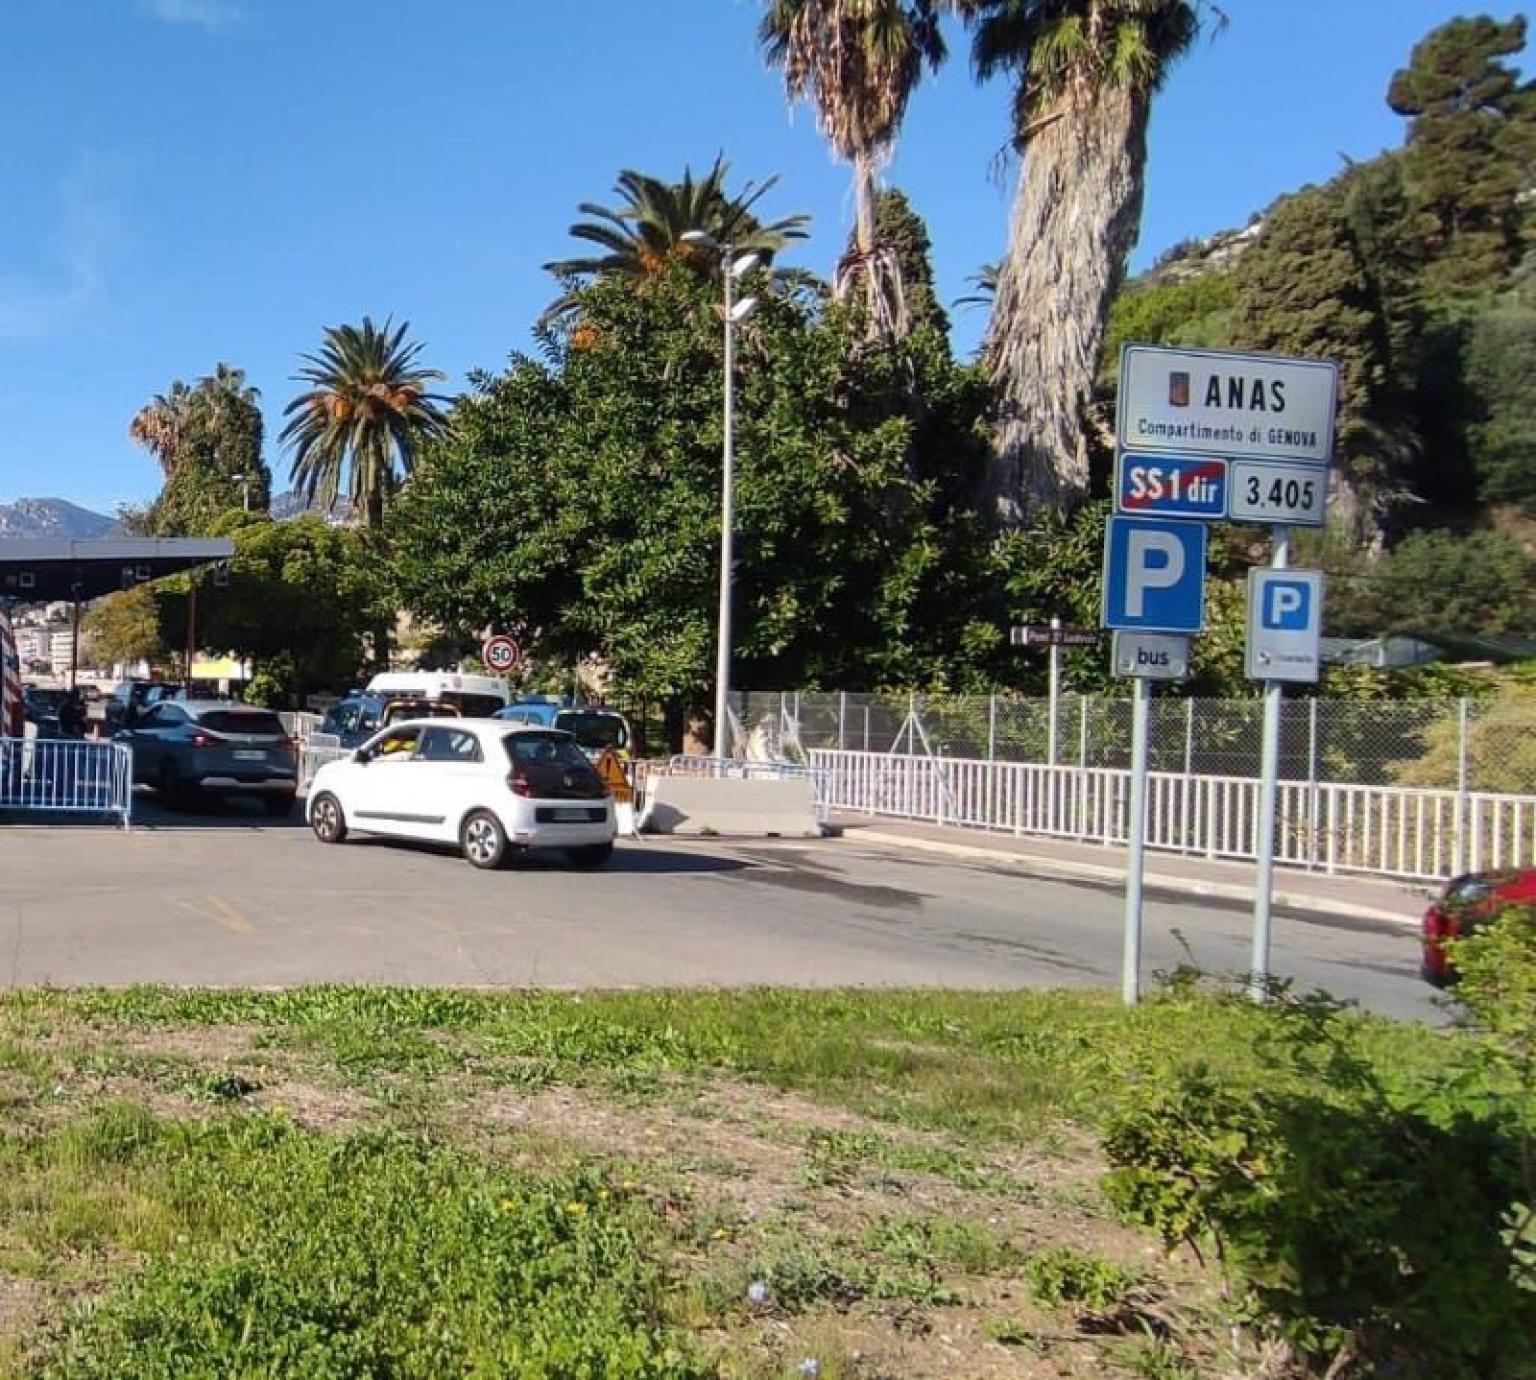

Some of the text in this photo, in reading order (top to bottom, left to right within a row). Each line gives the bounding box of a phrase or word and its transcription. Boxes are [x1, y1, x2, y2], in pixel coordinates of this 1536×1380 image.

[1204, 375, 1286, 413] ANAS
[1138, 418, 1317, 447] Compartimento di GENOVA
[1187, 475, 1219, 503] dir
[1125, 529, 1185, 617] P
[1270, 586, 1302, 624] P
[493, 646, 511, 662] 50
[1137, 647, 1169, 666] bus
